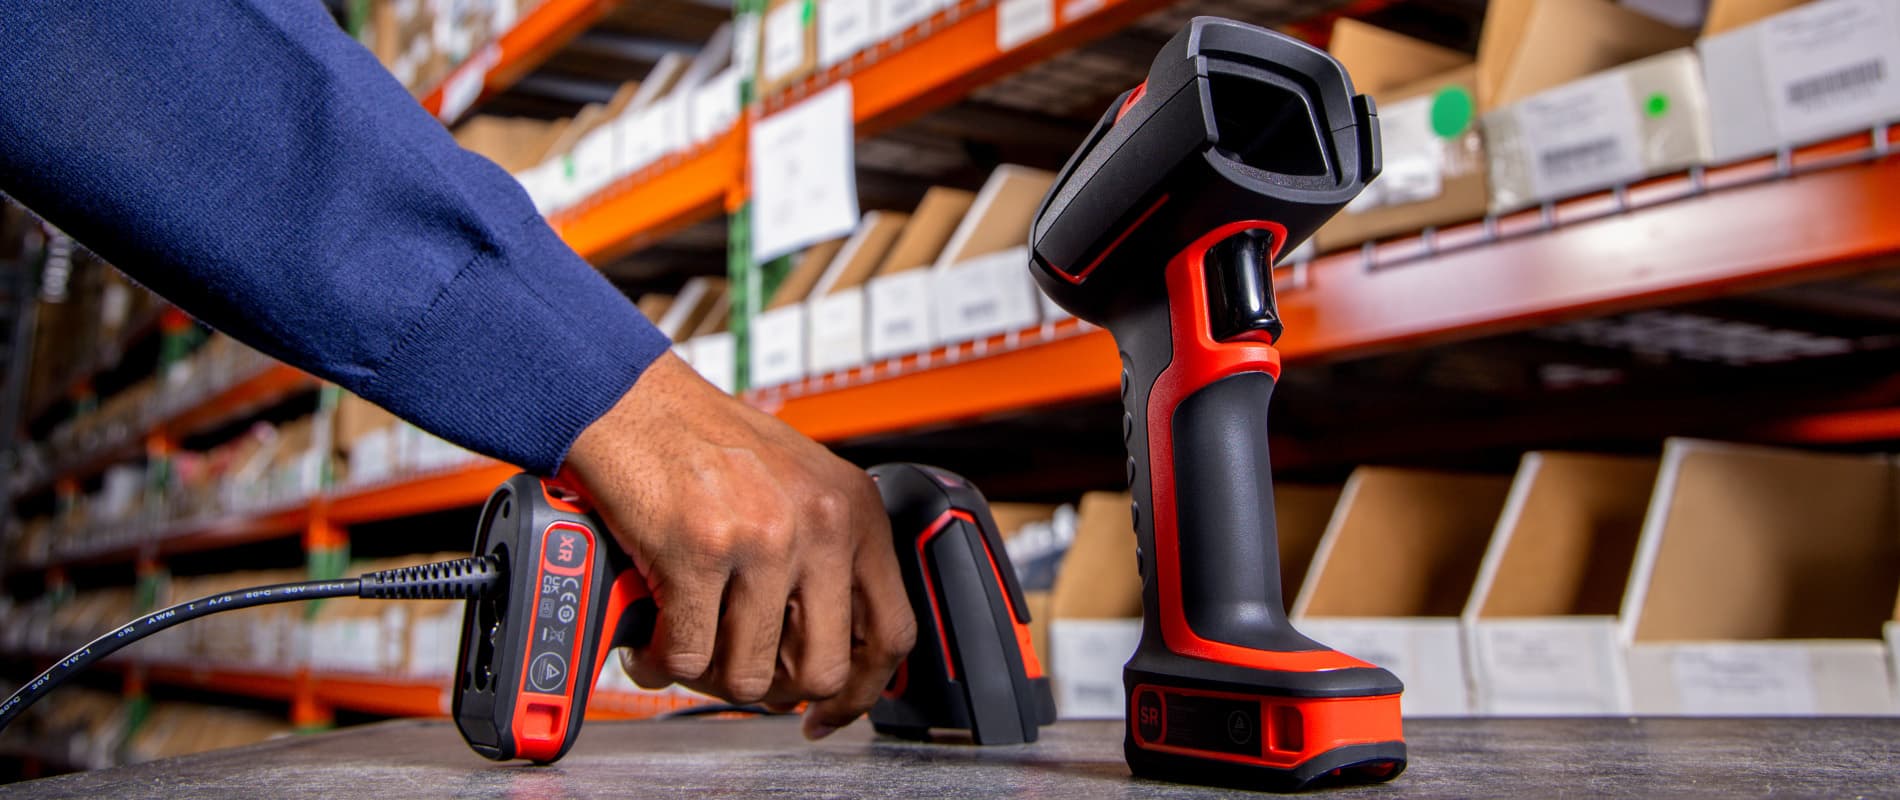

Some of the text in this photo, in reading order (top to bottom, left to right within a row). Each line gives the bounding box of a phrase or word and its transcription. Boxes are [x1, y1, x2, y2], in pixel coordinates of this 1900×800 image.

[558, 536, 575, 562] XR
[147, 609, 175, 625] AWM
[1141, 706, 1159, 728] SR
